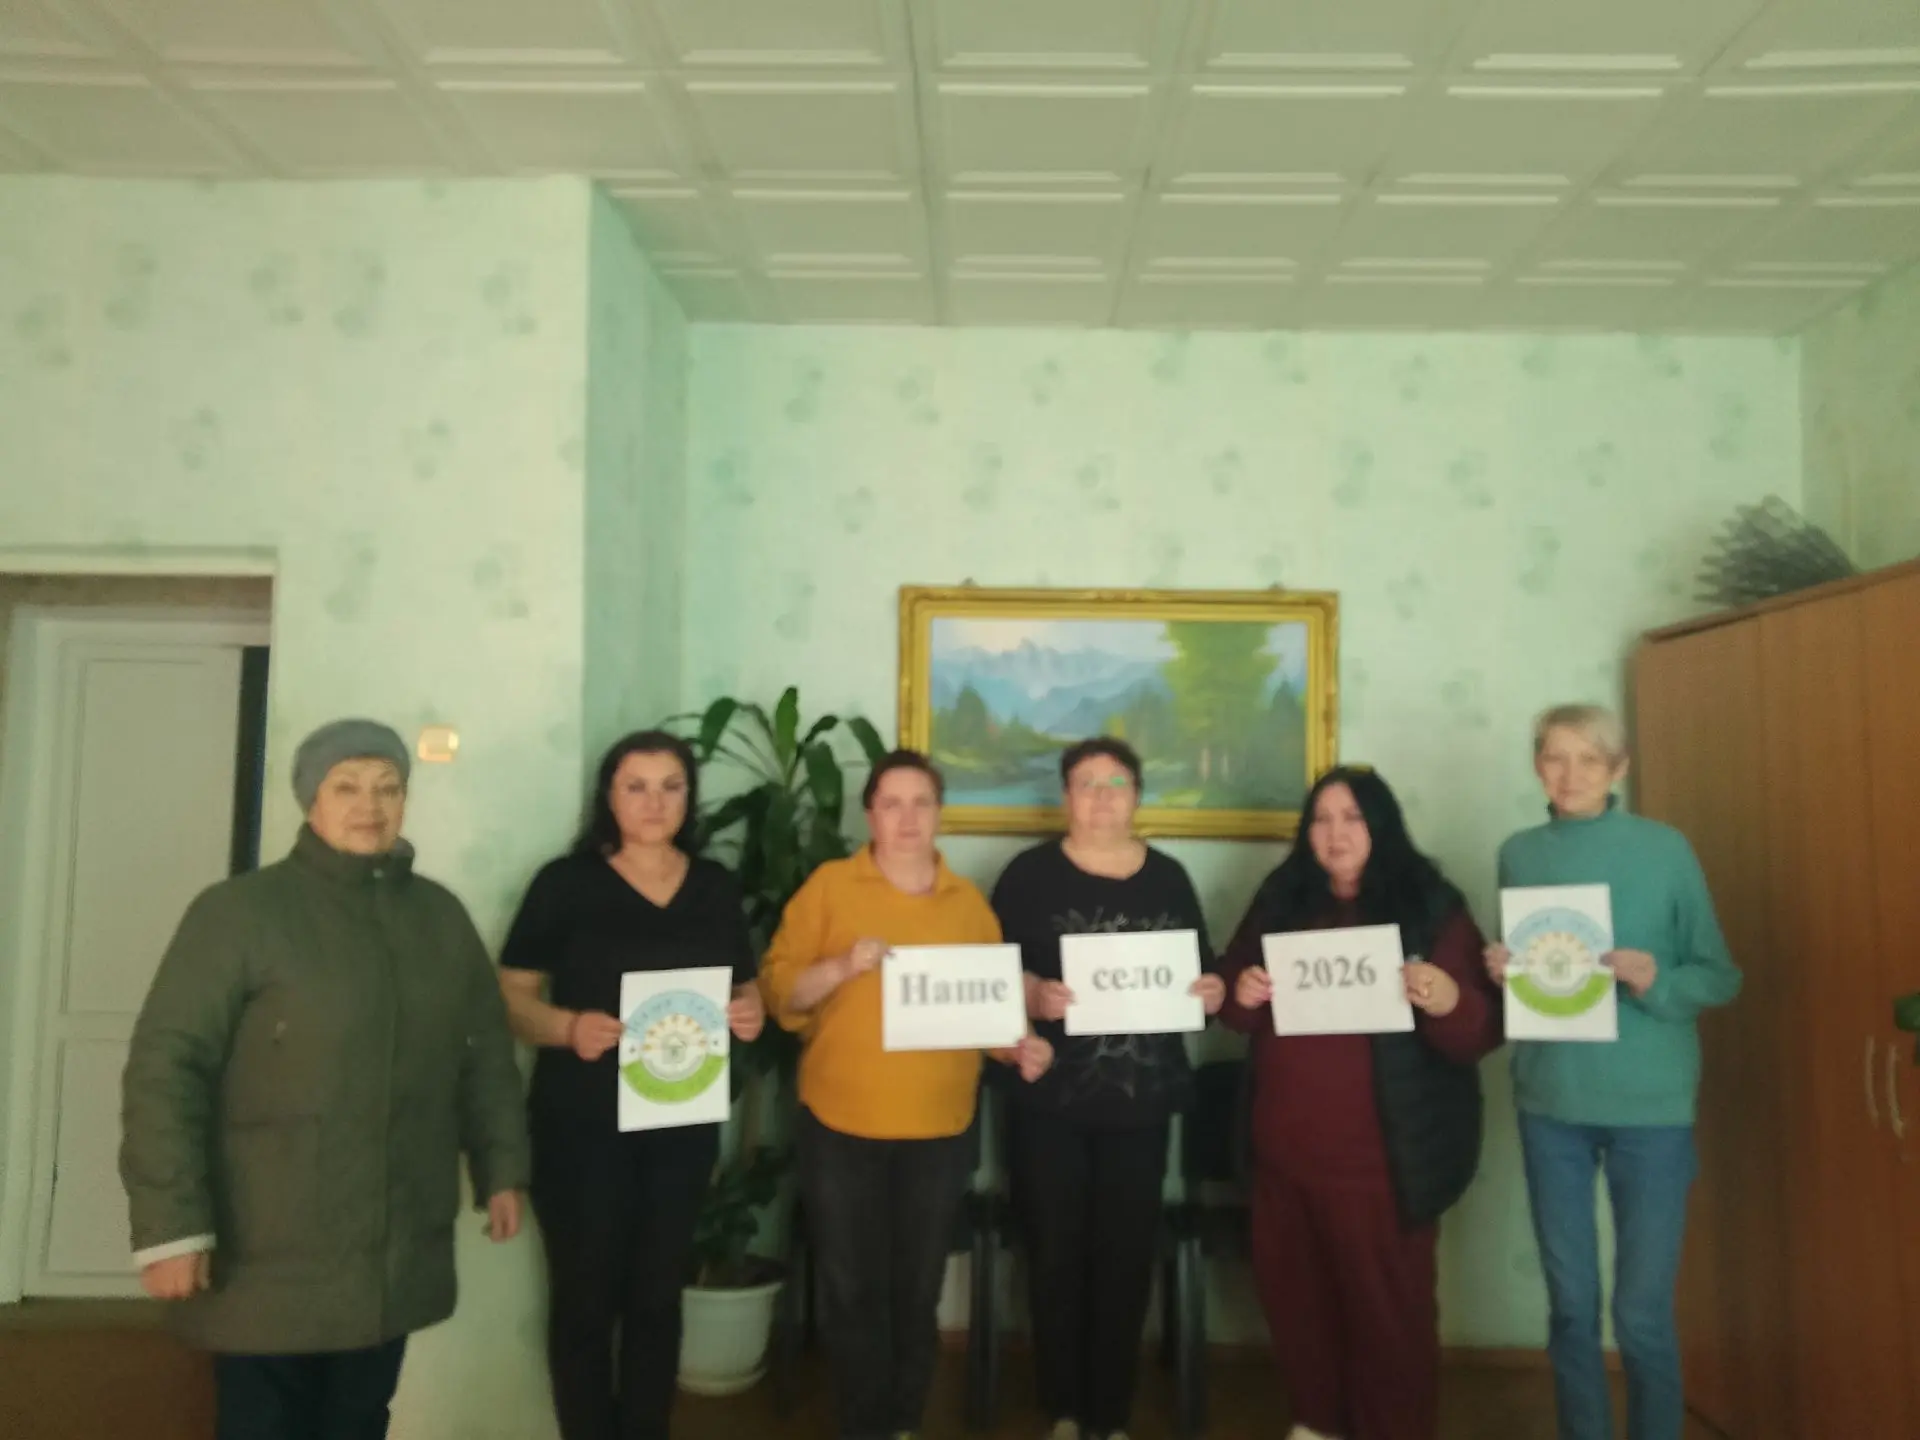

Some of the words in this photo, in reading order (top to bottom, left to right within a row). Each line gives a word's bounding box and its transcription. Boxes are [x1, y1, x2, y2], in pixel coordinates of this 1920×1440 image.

[898, 972, 1009, 1009] Наше
[1091, 963, 1174, 991] село
[1293, 954, 1378, 991] 2026
